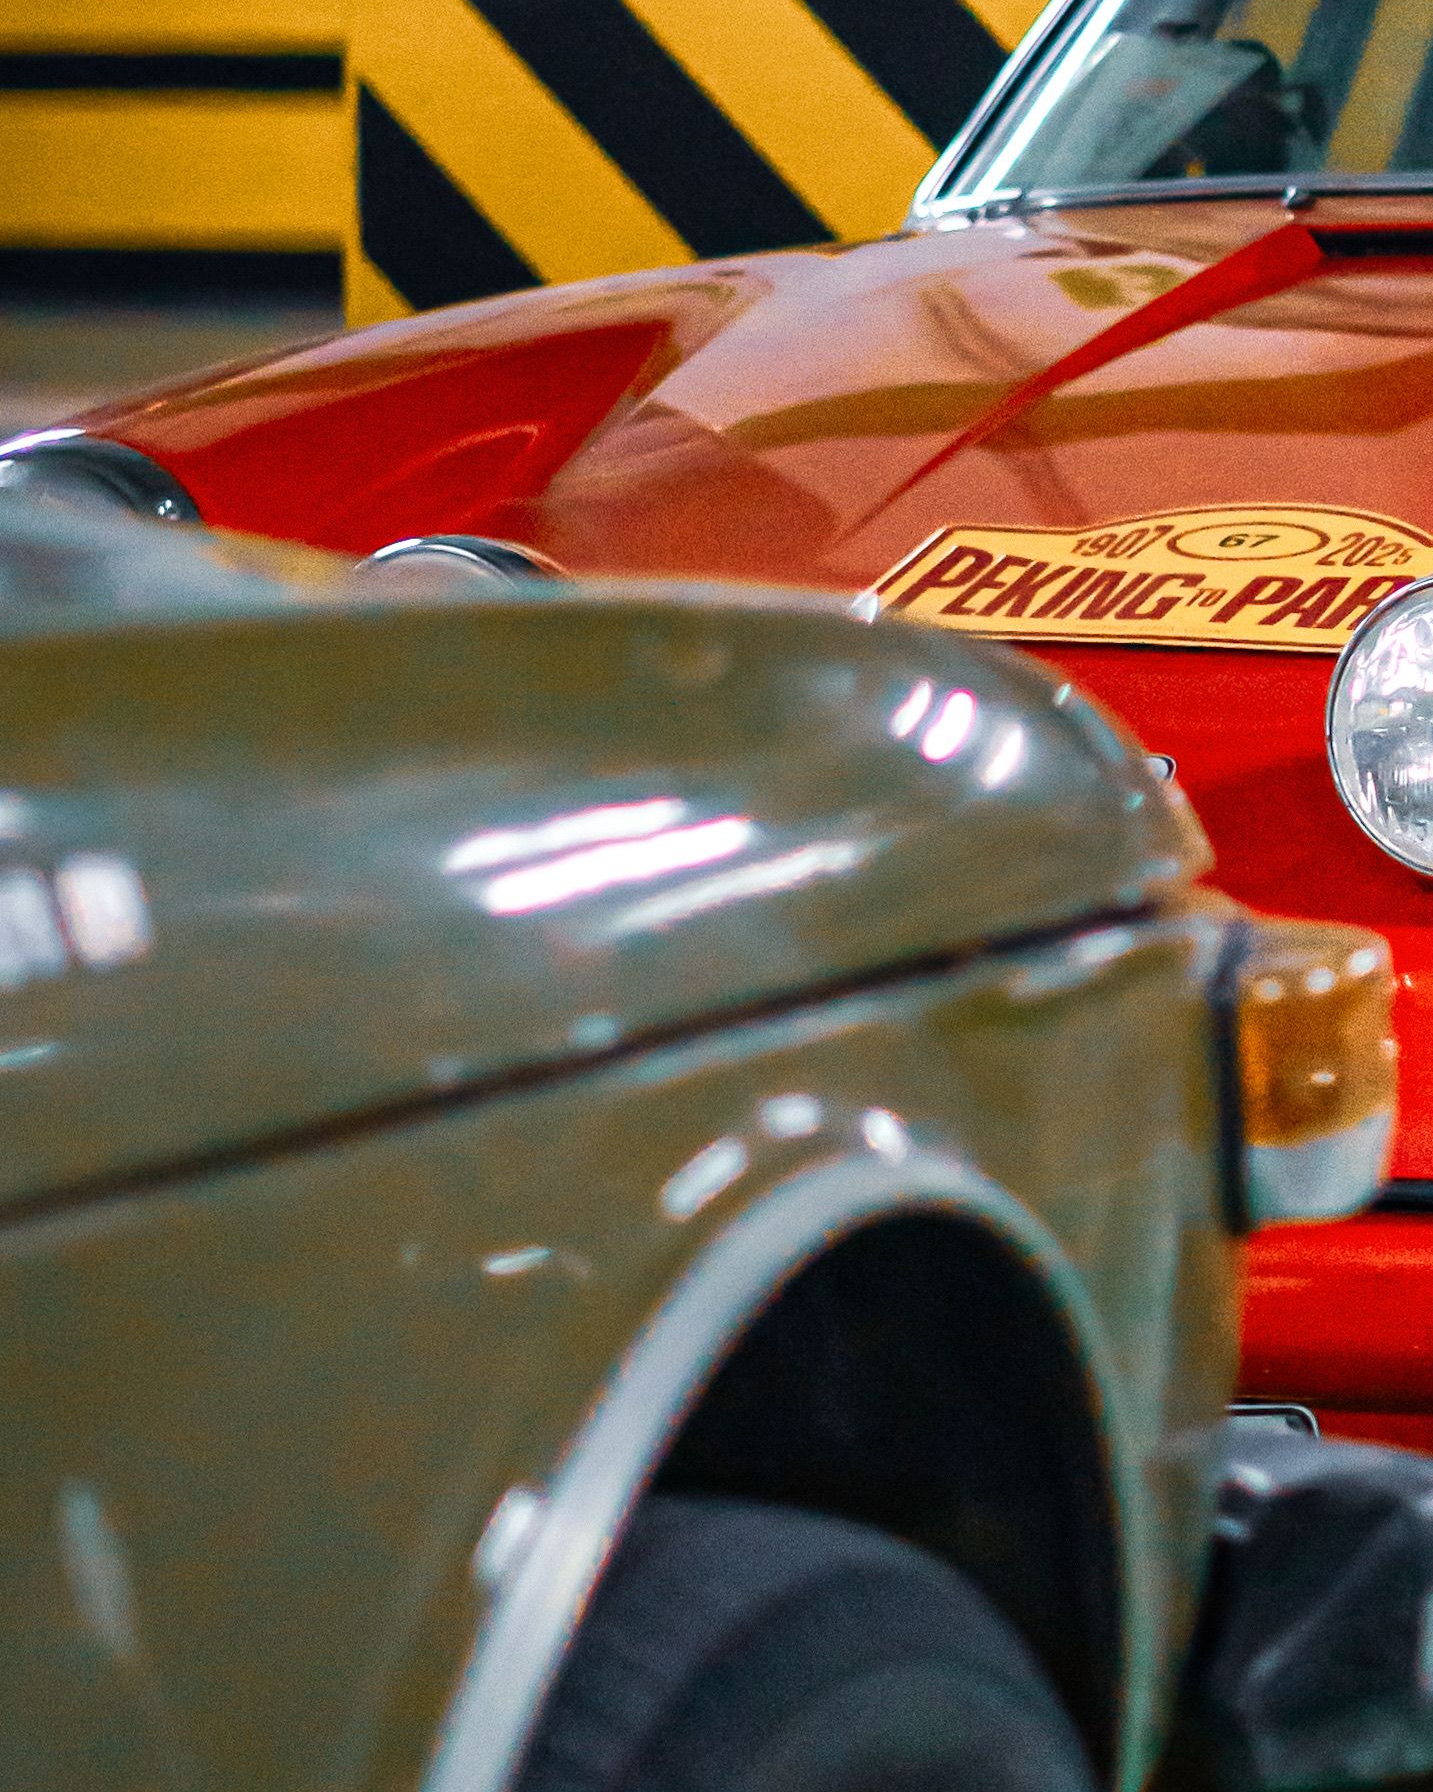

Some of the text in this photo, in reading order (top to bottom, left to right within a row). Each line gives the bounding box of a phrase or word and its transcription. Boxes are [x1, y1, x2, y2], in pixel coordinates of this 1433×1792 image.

[1071, 525, 1416, 567] 1907 67 2025
[893, 545, 1207, 621] PEKING
[1209, 575, 1416, 630] PAR
